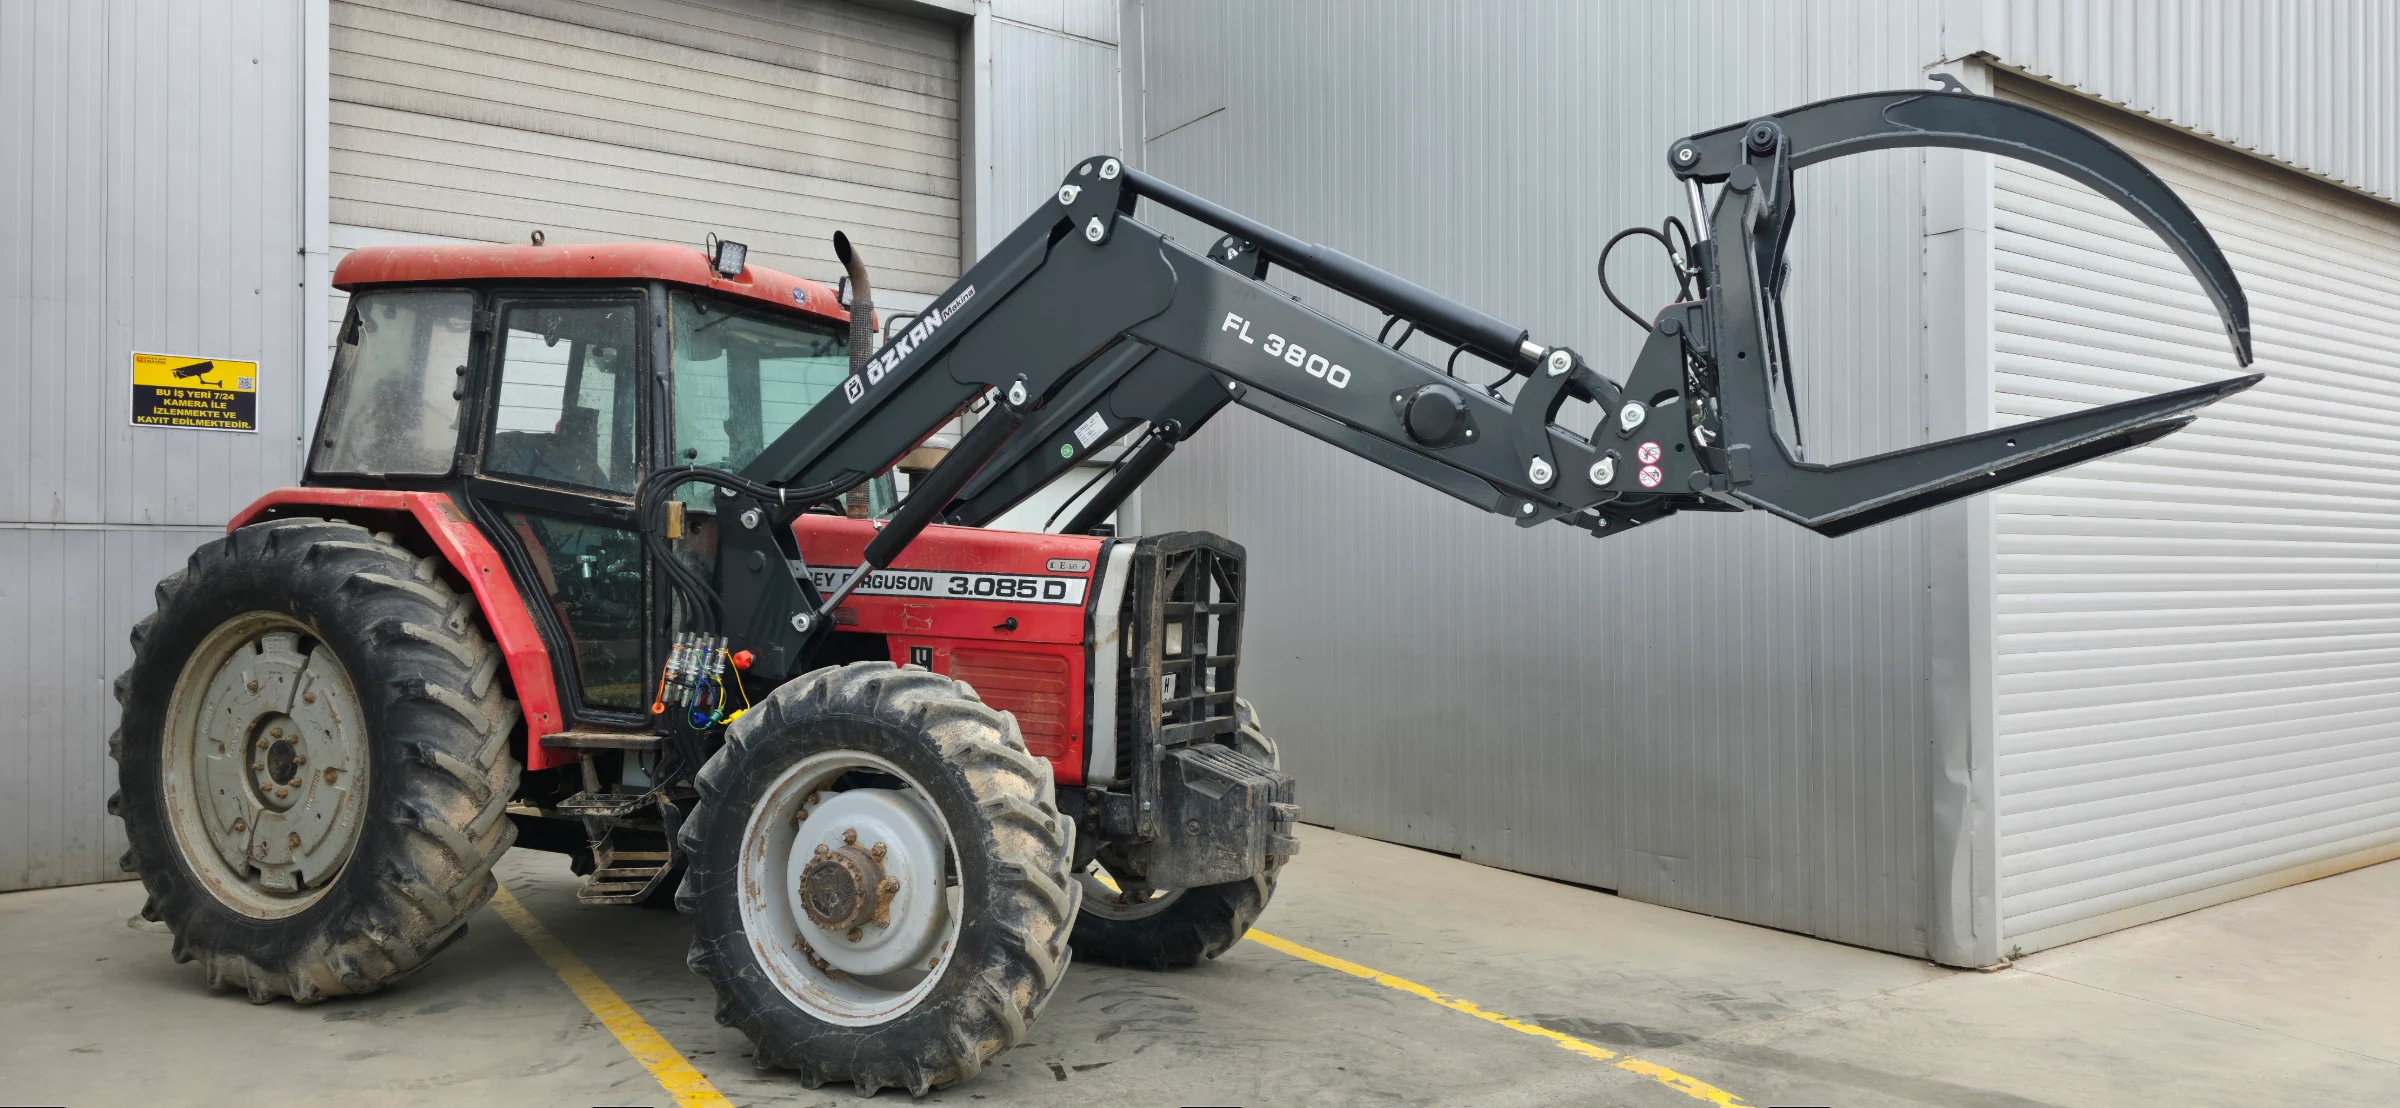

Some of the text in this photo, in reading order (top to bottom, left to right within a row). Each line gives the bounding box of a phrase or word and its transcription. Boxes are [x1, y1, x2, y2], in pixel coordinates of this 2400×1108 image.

[866, 307, 943, 386] ÖZKAN
[942, 287, 975, 320] Makina
[1221, 311, 1352, 389] FL 3800
[156, 388, 235, 401] BU İŞ YERİ 7/24
[163, 398, 227, 409] KAMERA İLE
[153, 405, 237, 419] İZLENMEKTE VE
[137, 415, 251, 429] KAYIT EDİLMEKTEDİR.
[841, 572, 934, 592] FRGUSON
[948, 576, 1038, 599] 3.085
[1043, 580, 1067, 600] D
